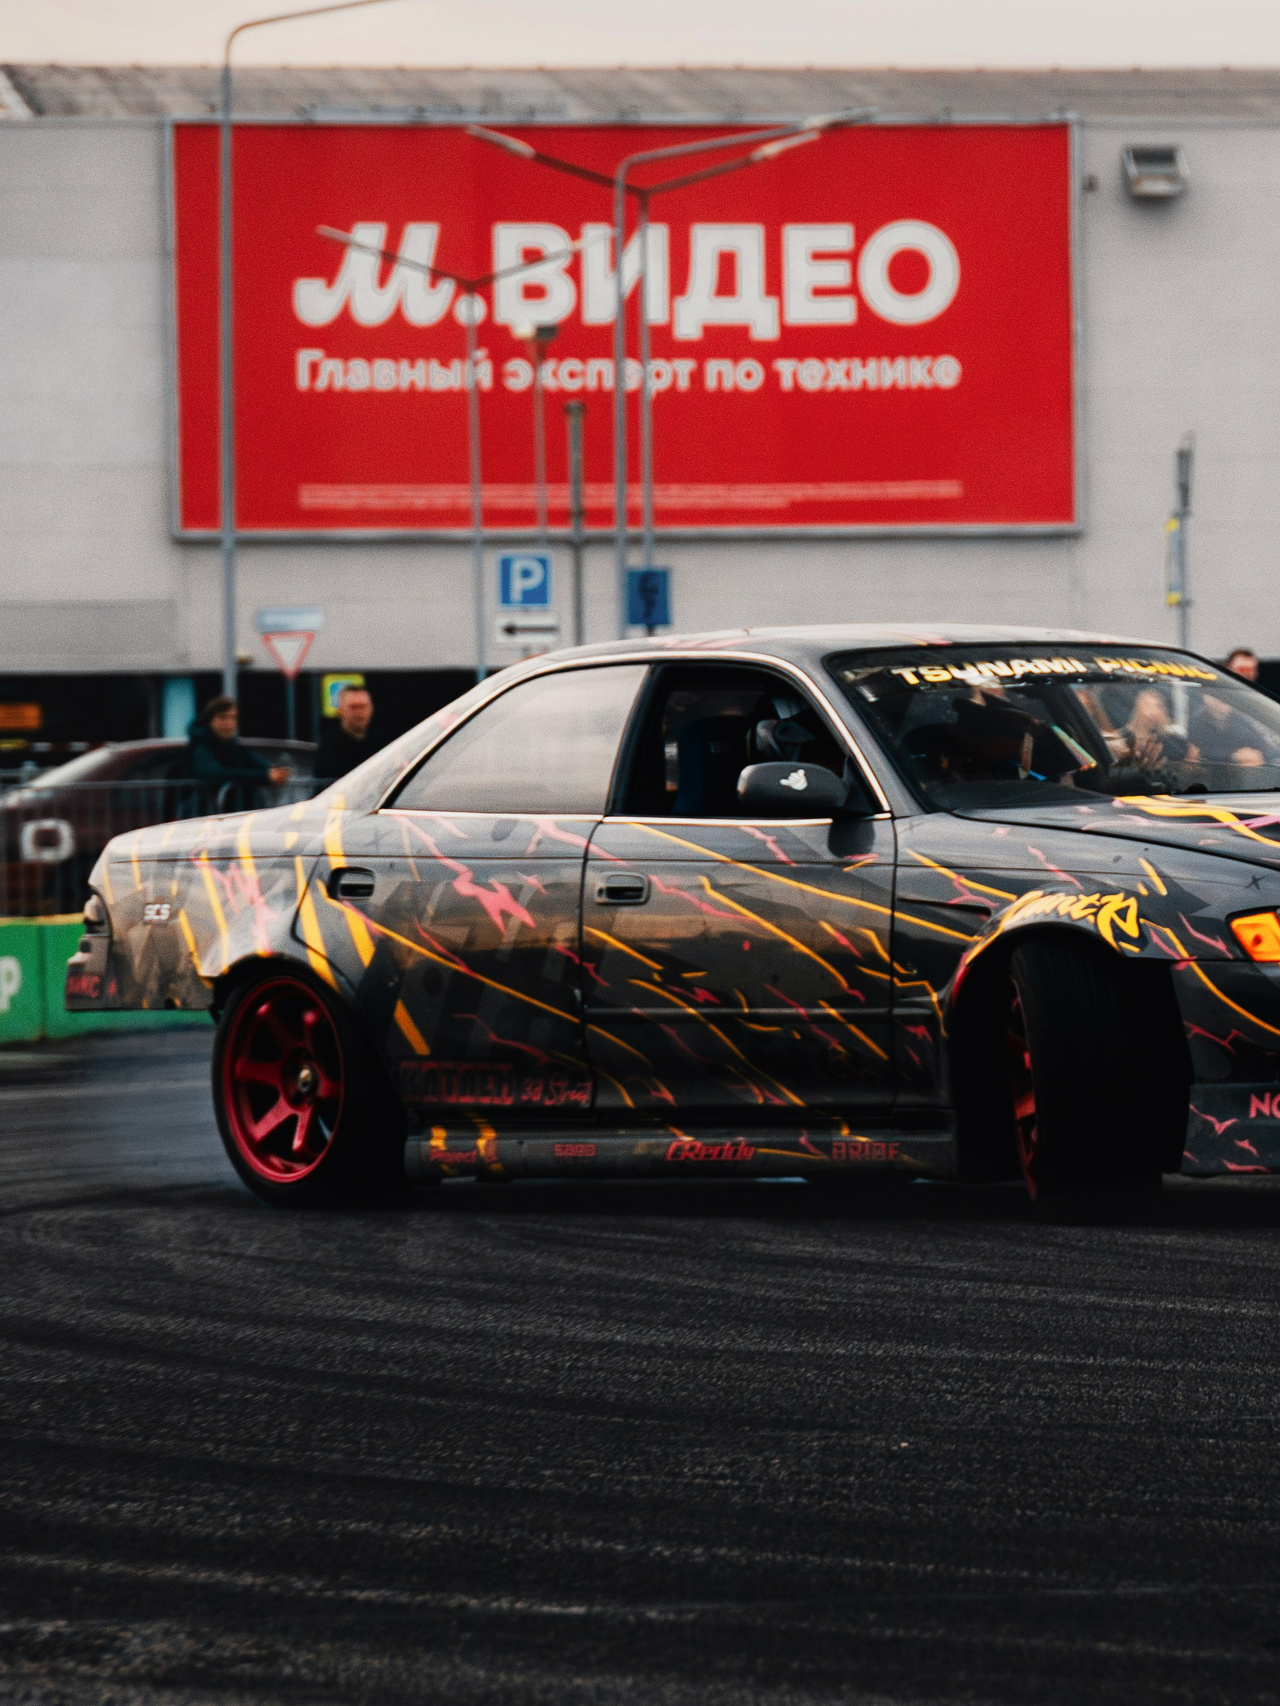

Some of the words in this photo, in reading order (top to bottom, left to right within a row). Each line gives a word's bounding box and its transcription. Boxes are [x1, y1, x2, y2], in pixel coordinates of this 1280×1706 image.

[295, 347, 493, 392] Главный
[503, 357, 697, 402] эксперт
[704, 357, 765, 392] по
[771, 353, 963, 392] технике
[891, 656, 1087, 685] TSUNAMI
